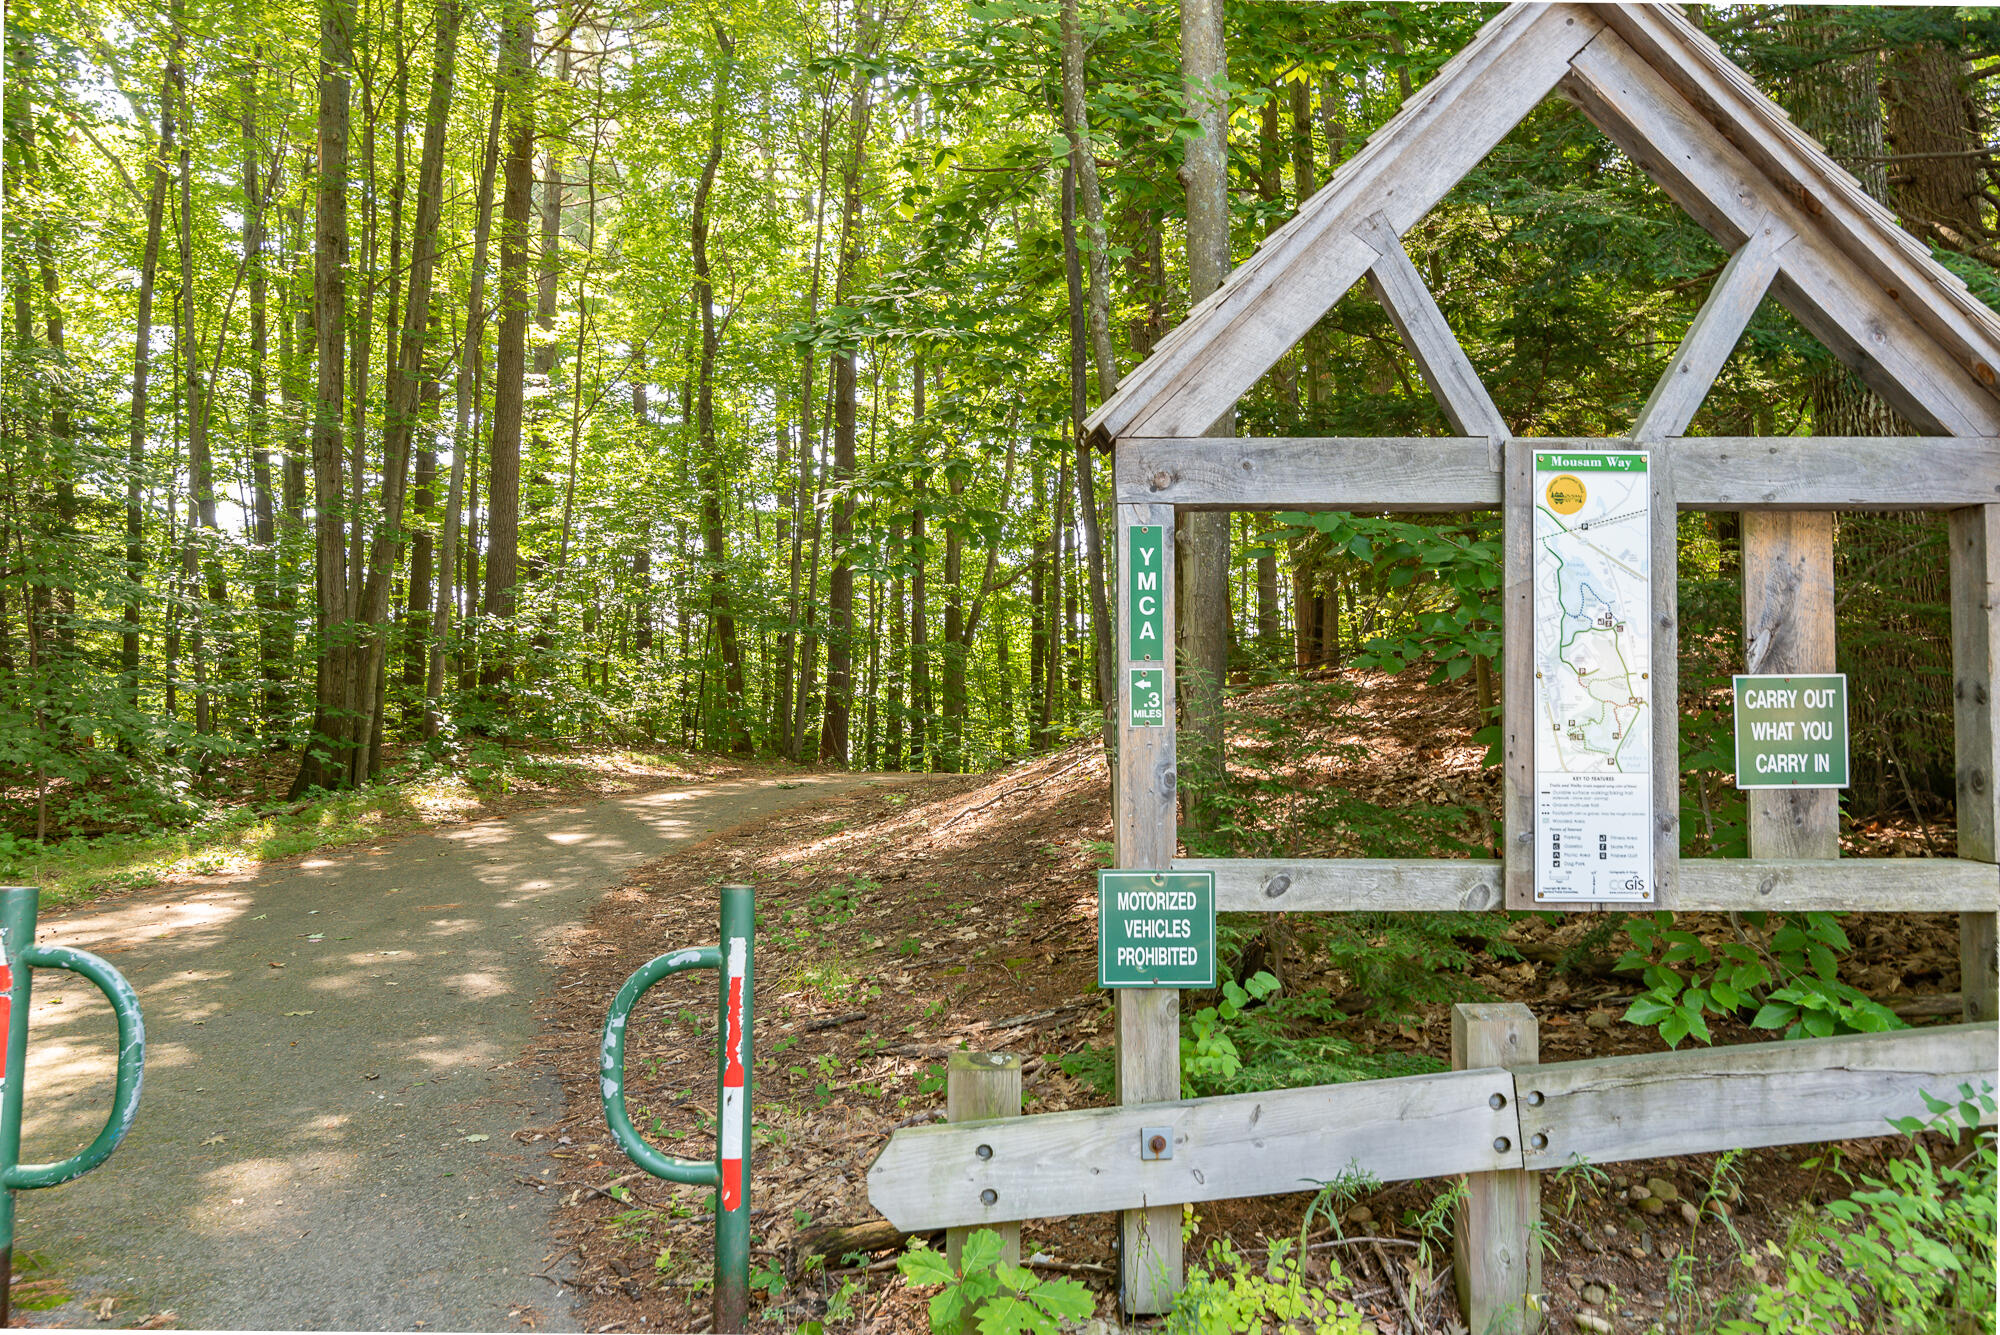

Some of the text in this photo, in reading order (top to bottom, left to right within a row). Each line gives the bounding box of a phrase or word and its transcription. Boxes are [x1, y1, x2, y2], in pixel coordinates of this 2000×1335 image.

[1551, 456, 1632, 470] Mousam Way
[1138, 547, 1157, 640] YMCA
[1143, 691, 1160, 708] .3
[1745, 689, 1836, 709] CARRY OUT
[1133, 709, 1162, 718] MILES
[1751, 721, 1832, 741] WHAT YOU
[1755, 753, 1830, 773] CARRY IN
[1117, 891, 1197, 911] MOTORIZED
[1124, 918, 1191, 938] VEHICLES
[1117, 947, 1198, 966] PROHIBITED
